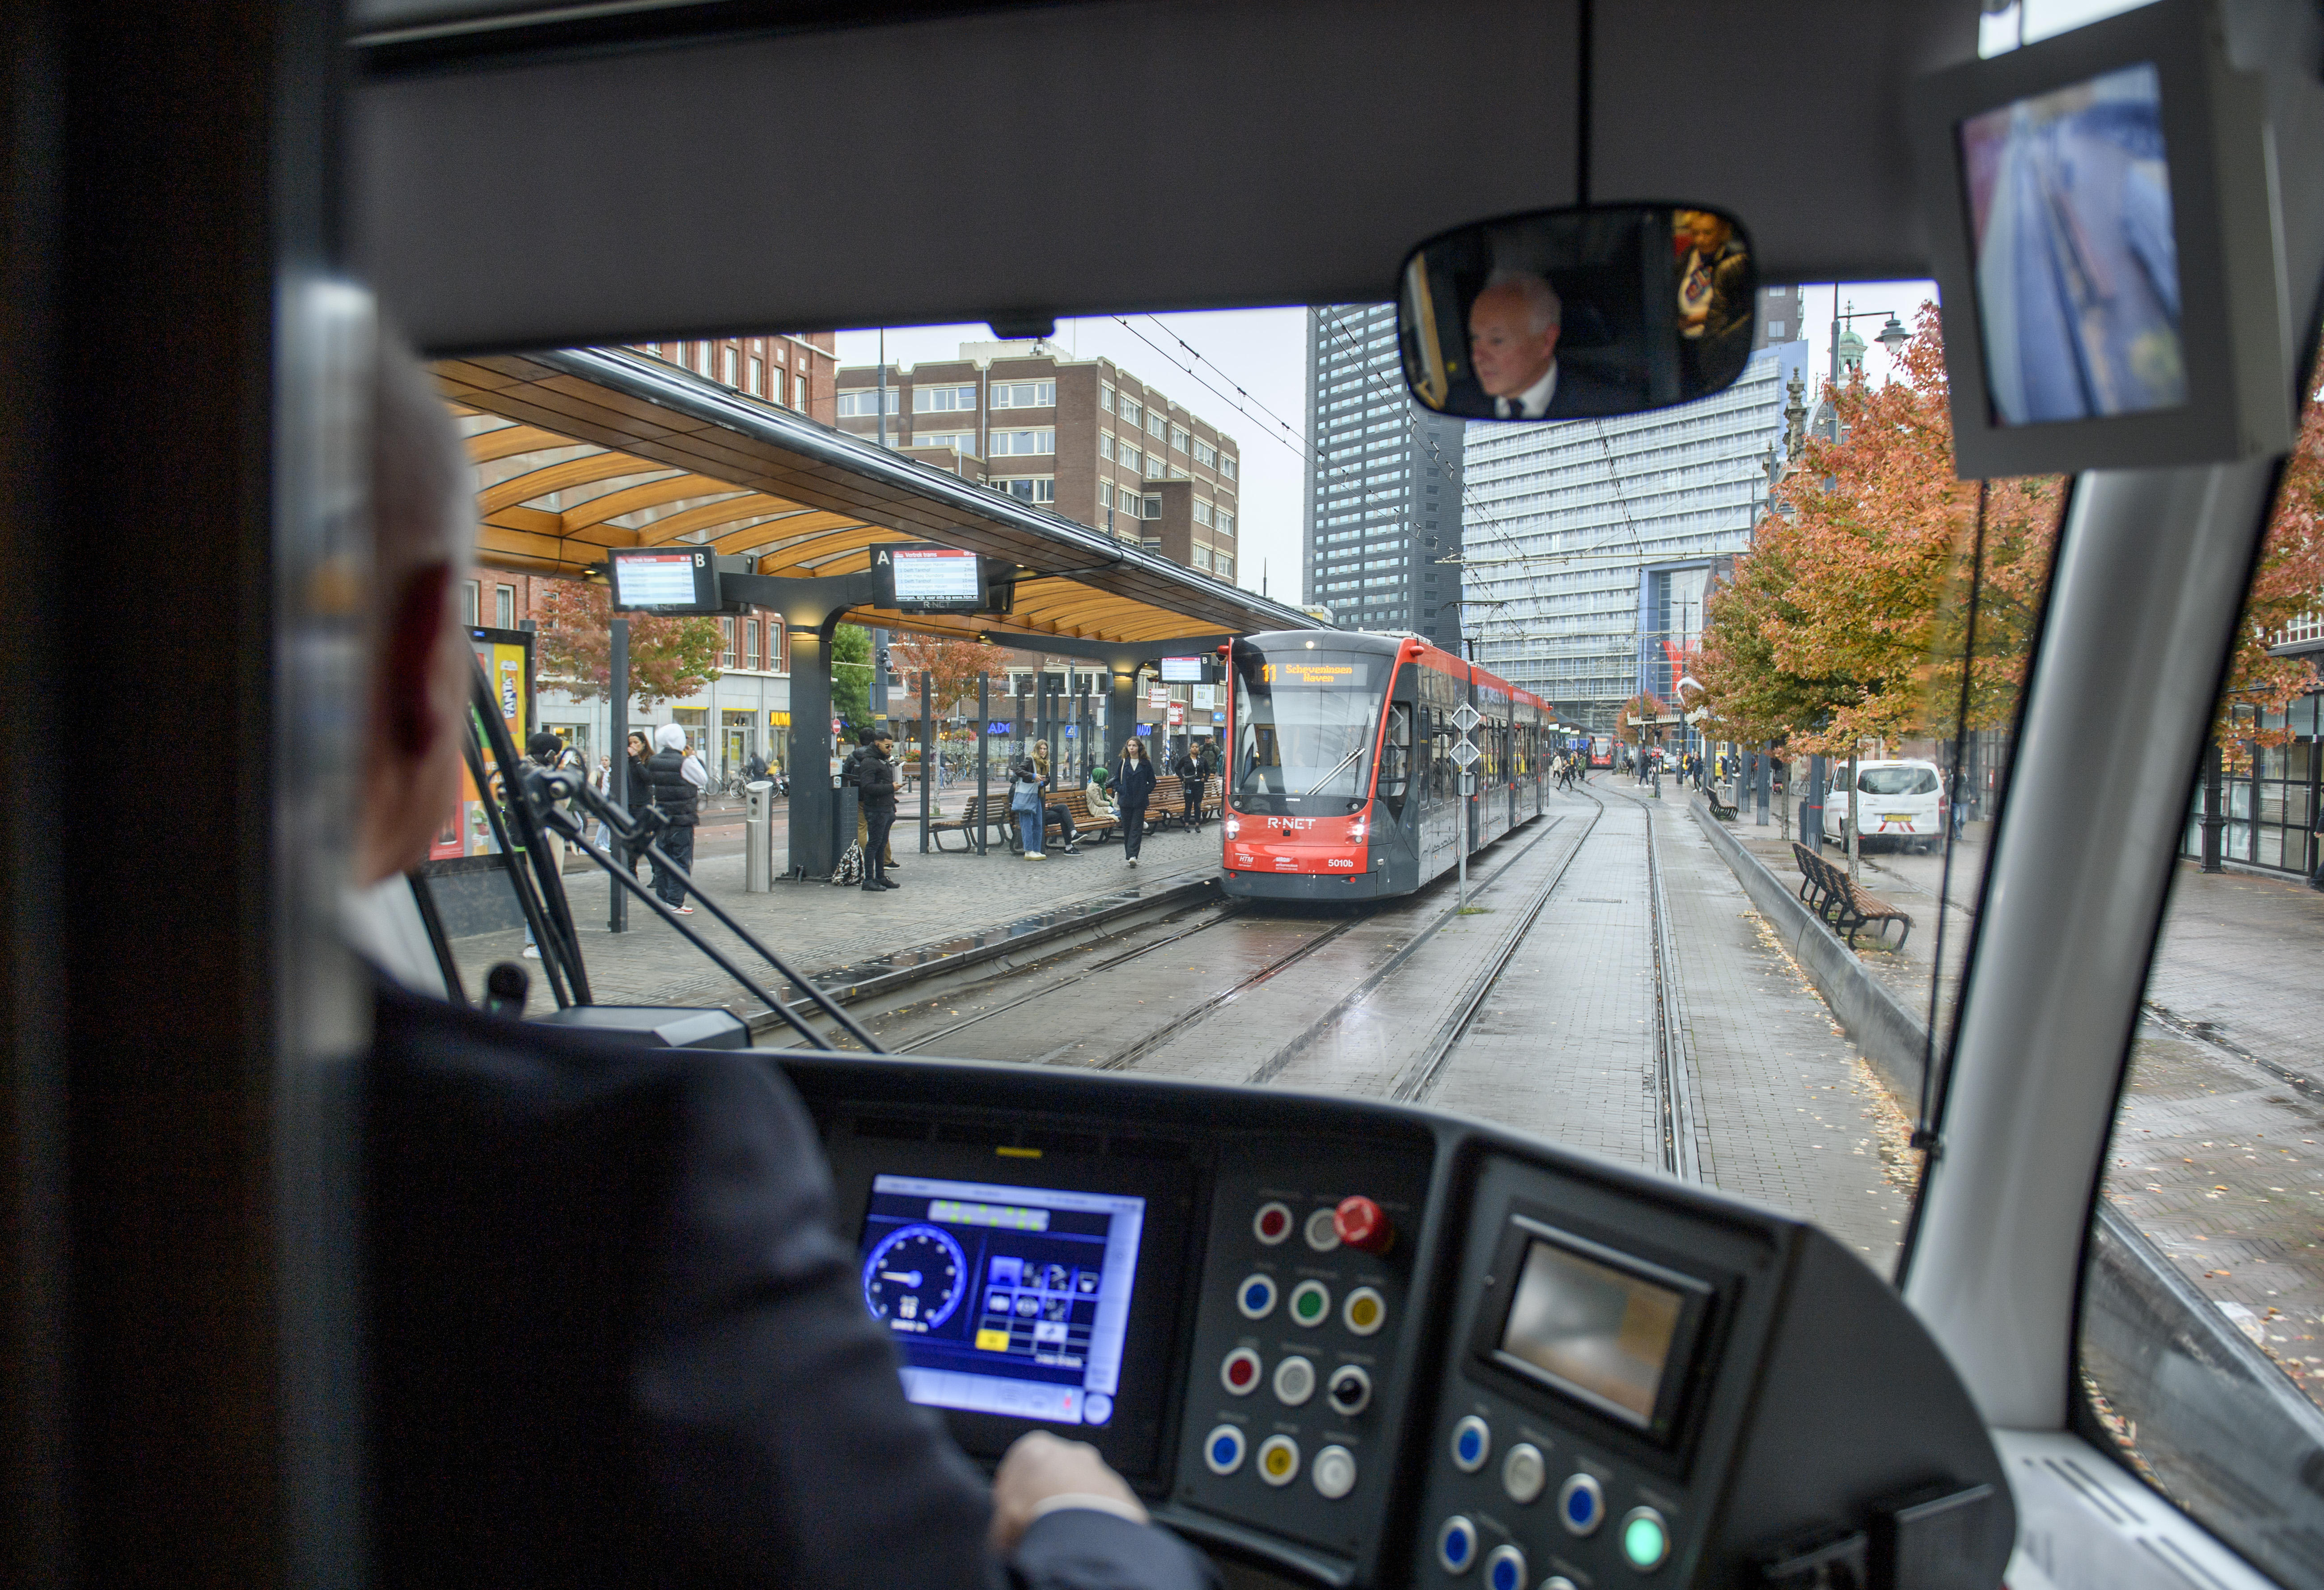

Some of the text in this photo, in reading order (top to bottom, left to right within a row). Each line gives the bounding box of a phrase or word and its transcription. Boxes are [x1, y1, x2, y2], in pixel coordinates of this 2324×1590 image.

[695, 554, 705, 567] B
[877, 550, 890, 565] A
[1261, 664, 1353, 682] 11 Scheveningen
[1303, 673, 1334, 682] Haven
[504, 677, 516, 719] FANTA
[1328, 858, 1354, 867] 5010b
